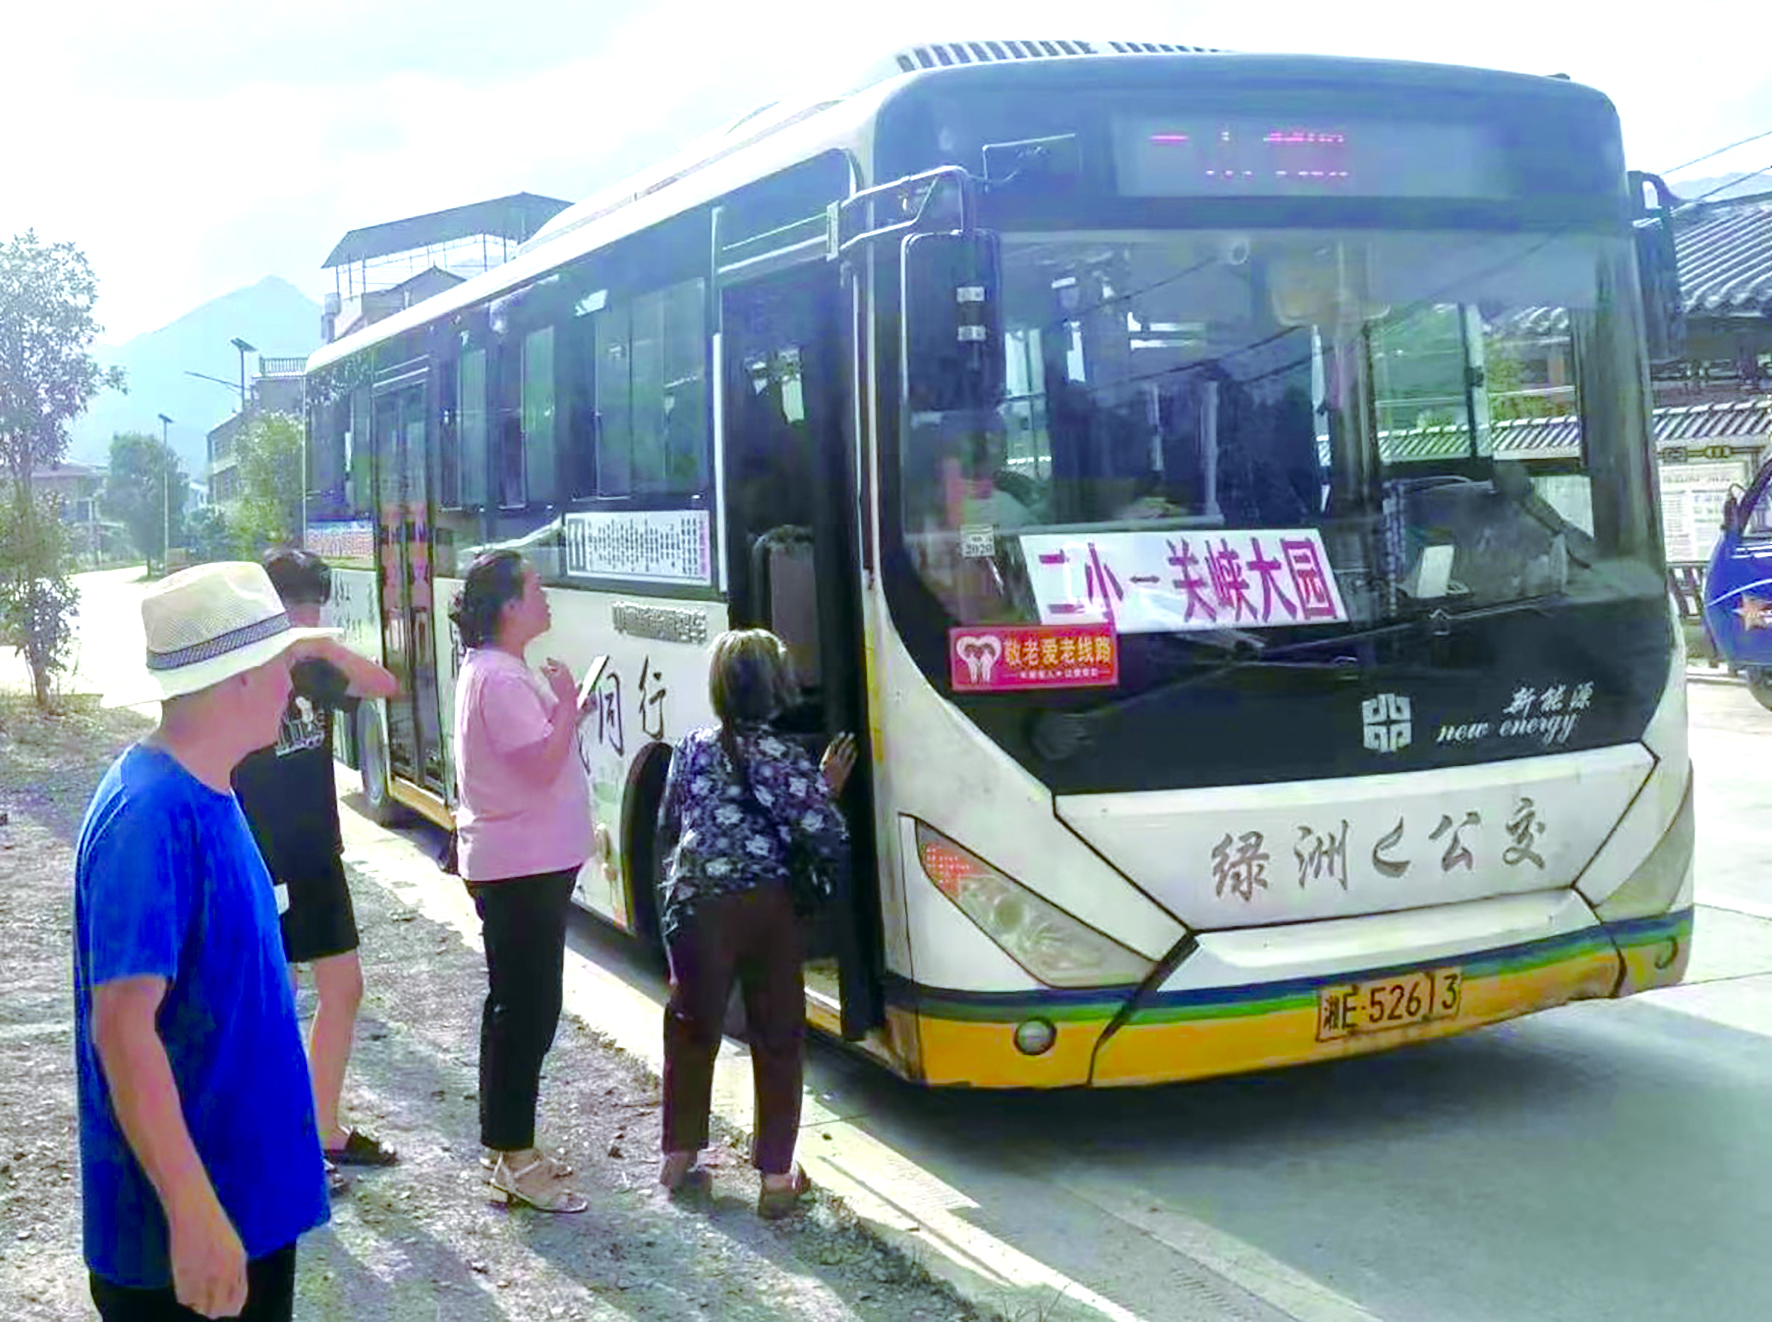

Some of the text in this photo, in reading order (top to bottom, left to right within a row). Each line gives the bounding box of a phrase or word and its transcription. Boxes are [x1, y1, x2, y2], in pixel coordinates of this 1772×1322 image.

[1502, 681, 1594, 717] 新能源
[1436, 713, 1577, 745] new energy
